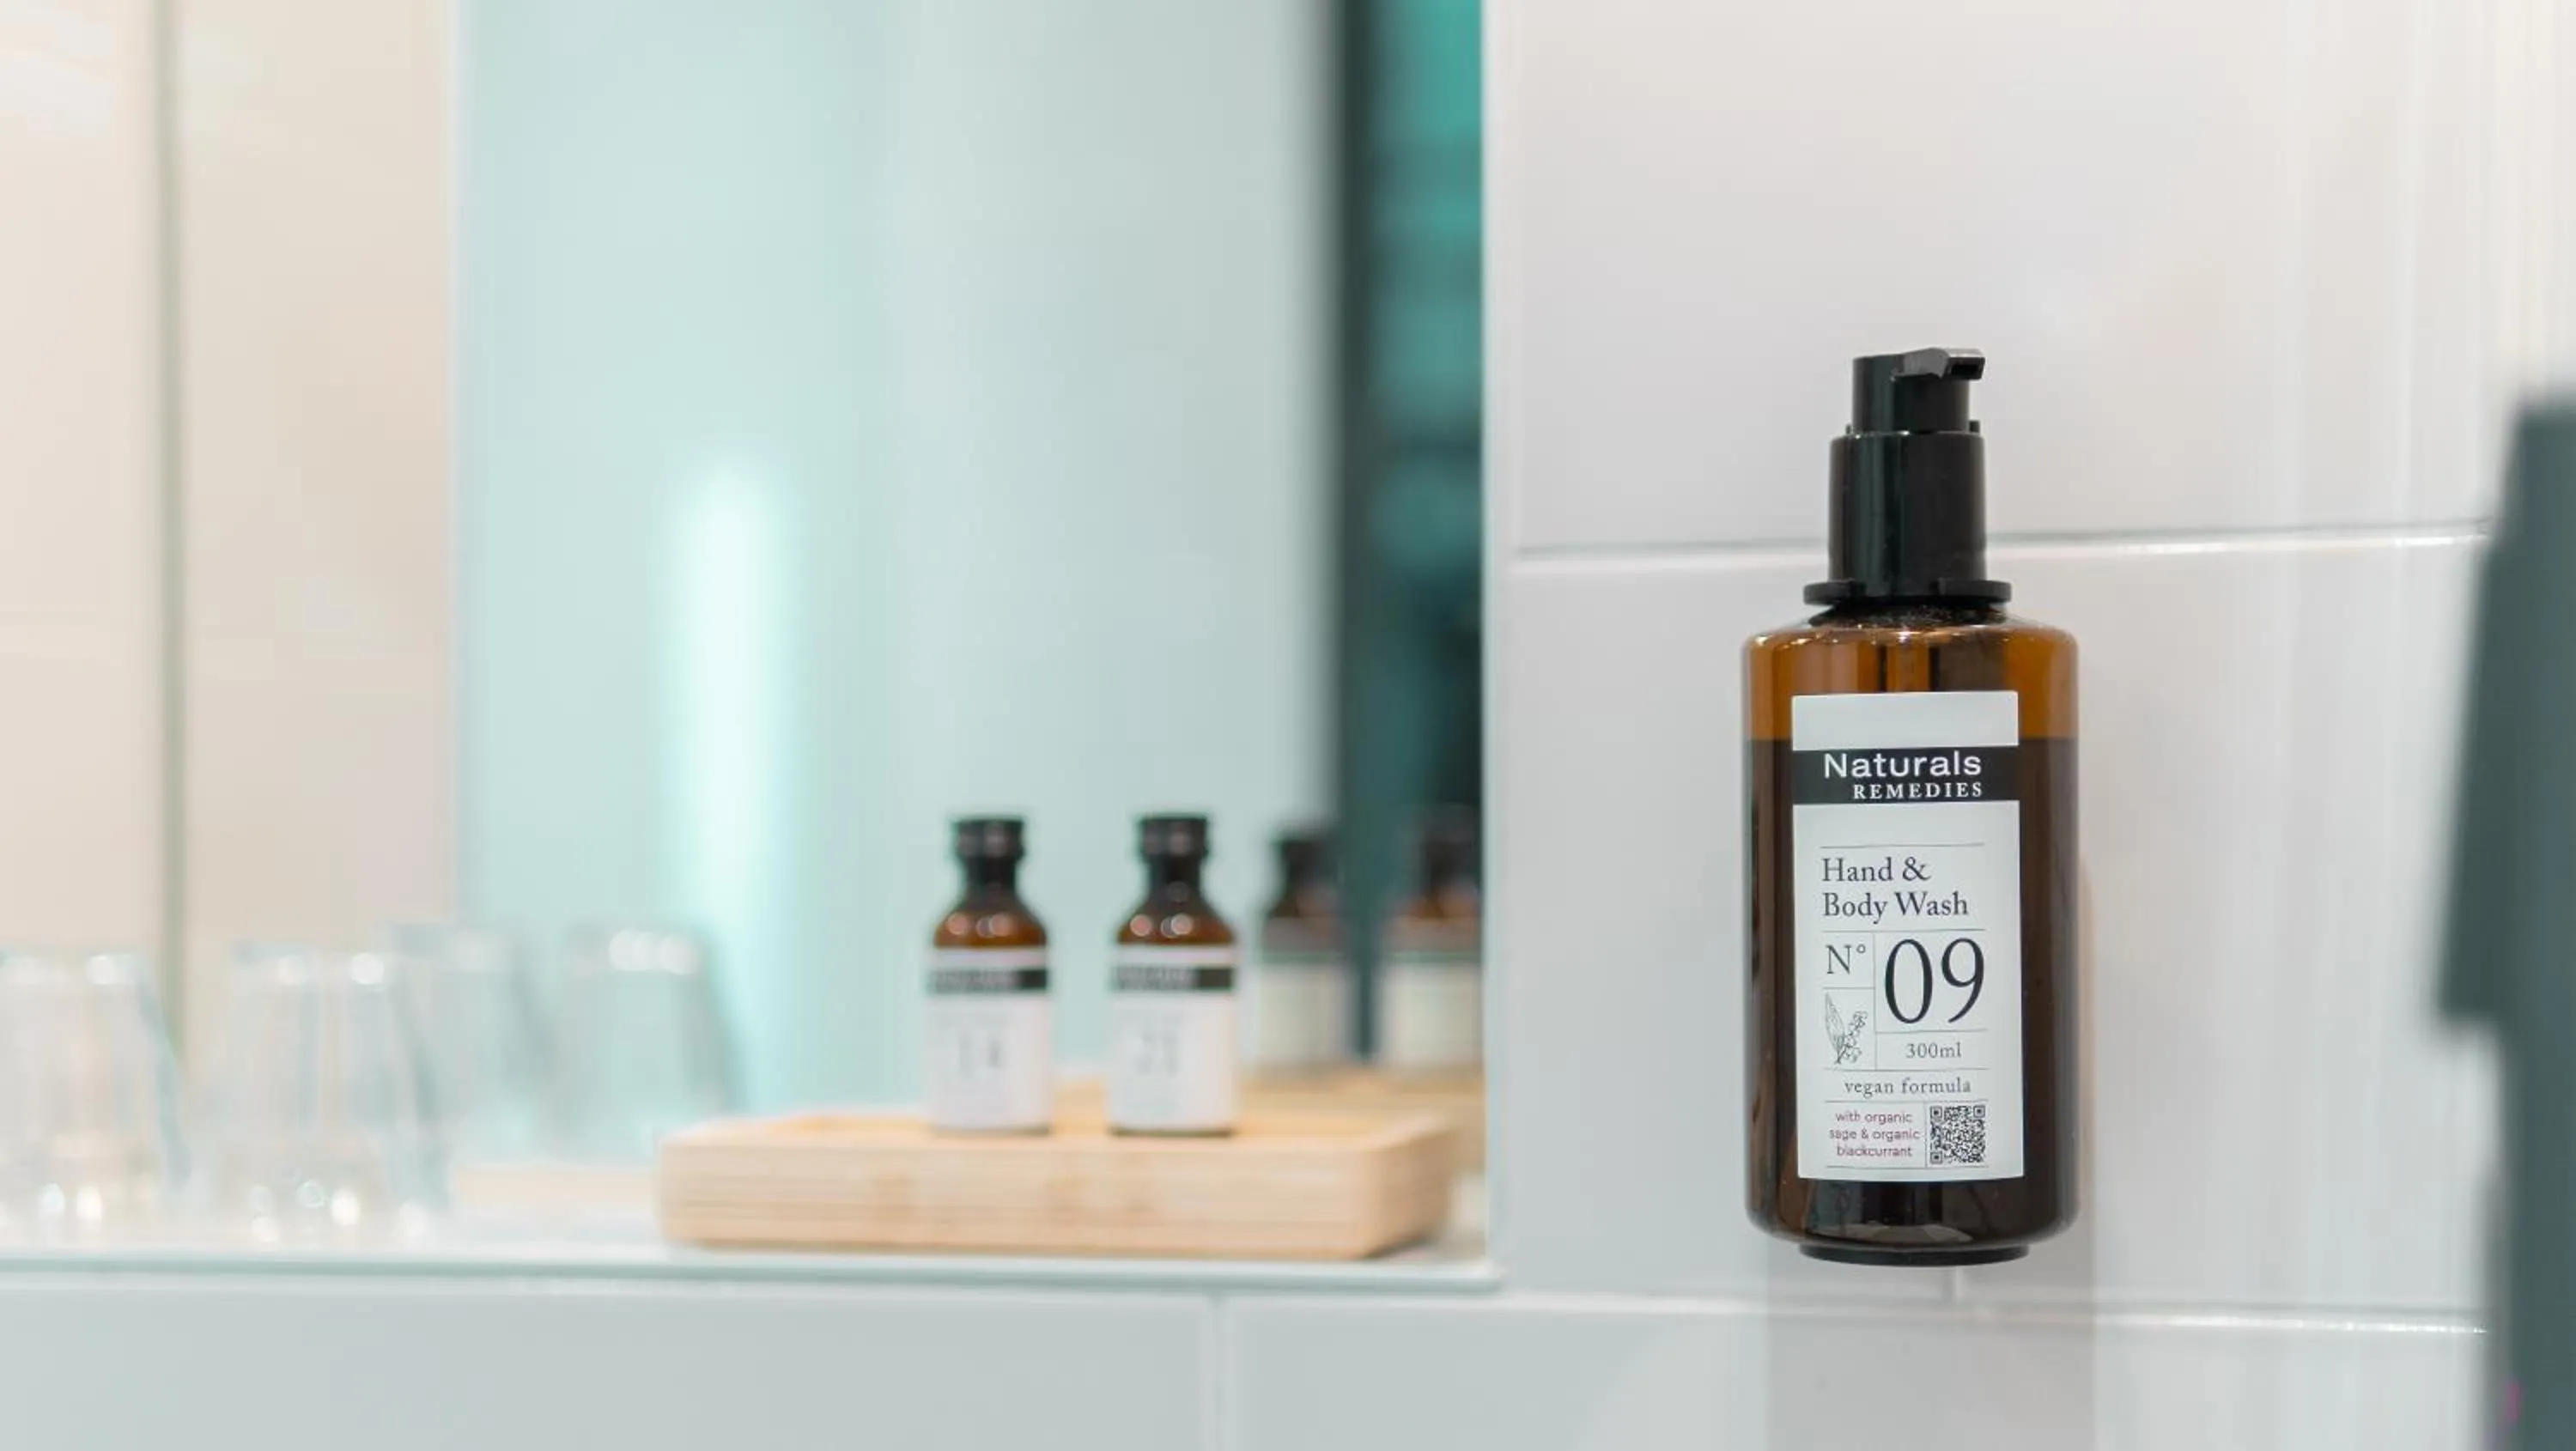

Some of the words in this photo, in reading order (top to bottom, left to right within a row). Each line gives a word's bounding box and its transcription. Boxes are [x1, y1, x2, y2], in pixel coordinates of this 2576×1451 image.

[1823, 750, 1983, 779] Naturals
[1852, 781, 1984, 800] REMEDIES
[1821, 855, 1894, 883] Hand
[1901, 856, 1932, 882] &
[1823, 891, 1887, 925] Body
[1894, 889, 1969, 917] Wash
[1884, 938, 1985, 1024] 09
[1905, 1041, 1963, 1059] 300ml
[1844, 1080, 1894, 1098] vegan
[1900, 1076, 1972, 1095] formula
[1835, 1110, 1861, 1124] with
[1864, 1110, 1914, 1126] organic
[1829, 1128, 1857, 1141] sage
[1861, 1127, 1869, 1140] &
[1872, 1127, 1922, 1142] organic
[1836, 1143, 1914, 1157] blackcurrant
